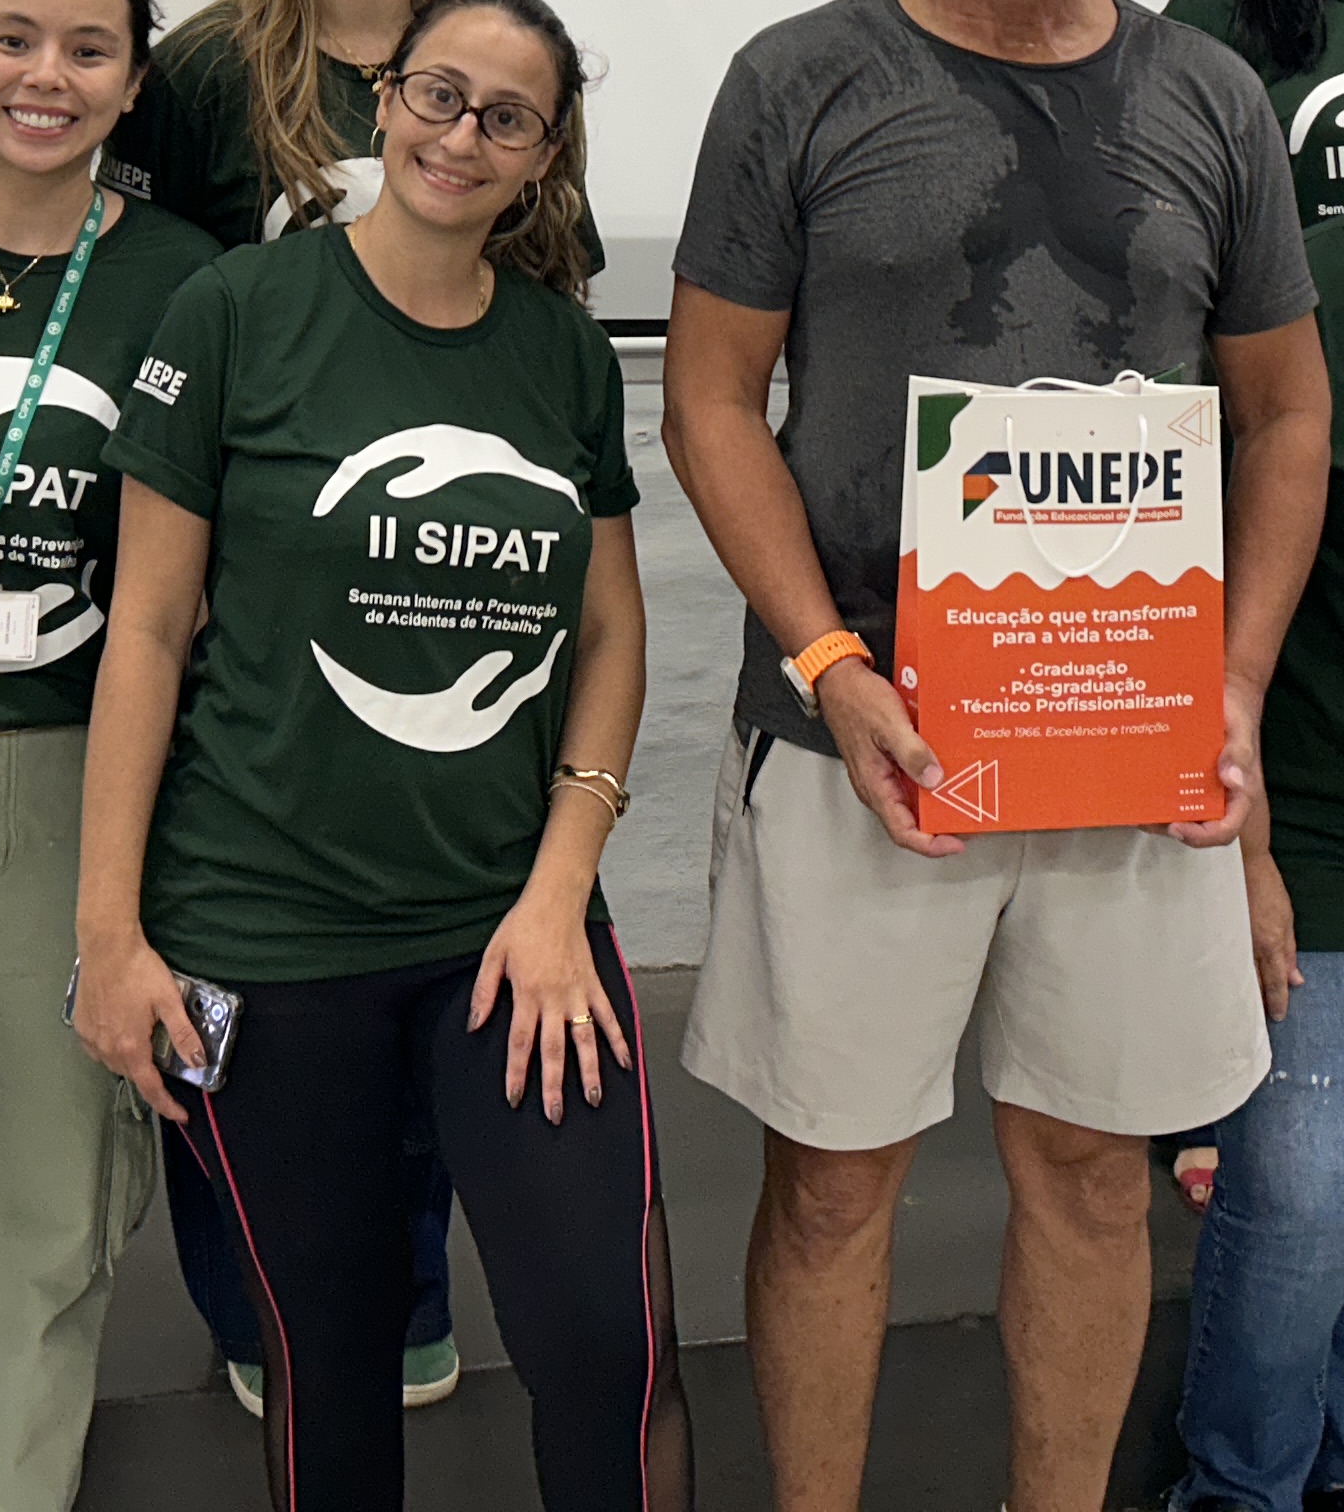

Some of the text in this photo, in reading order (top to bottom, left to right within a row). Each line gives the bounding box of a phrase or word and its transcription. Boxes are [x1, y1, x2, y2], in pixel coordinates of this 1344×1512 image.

[10, 531, 28, 548] de
[368, 515, 560, 573] II SIPAT
[8, 549, 26, 563] de
[348, 587, 558, 620] Semana Interna de Prevenção
[365, 609, 542, 635] de Acidentes de Trabalho
[946, 605, 1198, 629] Educação que transforma
[993, 626, 1155, 648] para a vida toda.
[1030, 660, 1128, 680] Graduação
[1011, 677, 1146, 698] Pós-graduação
[961, 693, 1194, 714] Técnico Profissionalizante
[974, 727, 1011, 738] Desde
[1045, 724, 1109, 738] Excelência
[1110, 726, 1119, 735] e
